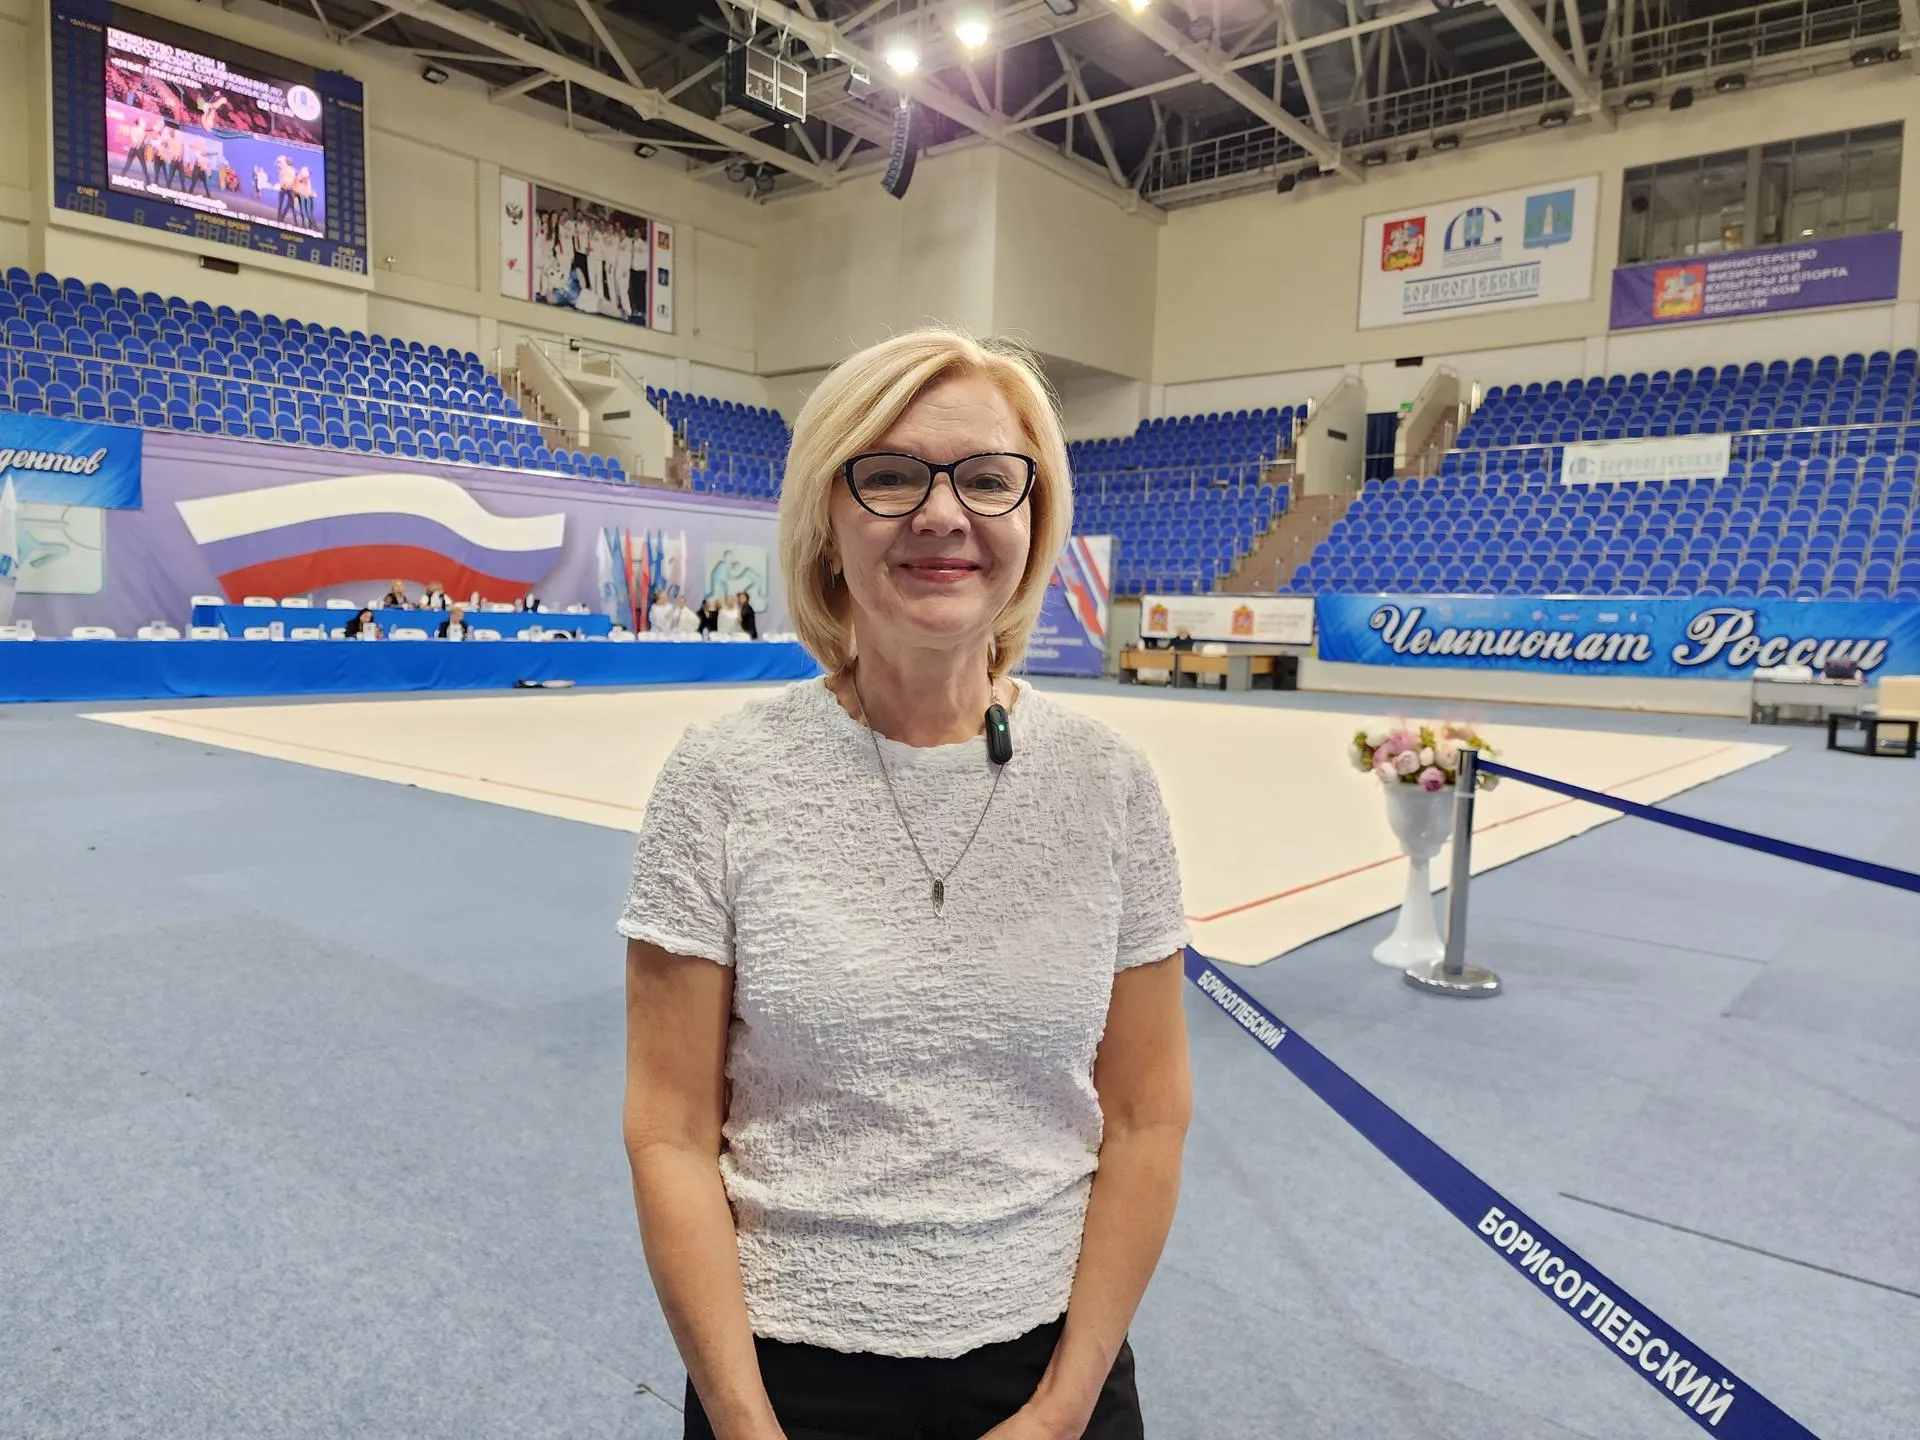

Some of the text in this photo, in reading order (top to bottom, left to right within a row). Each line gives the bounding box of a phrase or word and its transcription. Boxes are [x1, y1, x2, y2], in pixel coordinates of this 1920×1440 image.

[1706, 261, 1801, 283] ФИЗИЧЕСКОЙ
[1707, 248, 1818, 272] МИНИСТЕРСТВО
[1778, 274, 1789, 284] И
[1791, 266, 1848, 283] СПОРТА
[1369, 604, 1889, 671] Чемпионат России
[1197, 969, 1287, 1050] БОРИСОГЛЕБСКИЙ
[1477, 1206, 1736, 1427] БОРИСОГЛЕБСКИЙ
